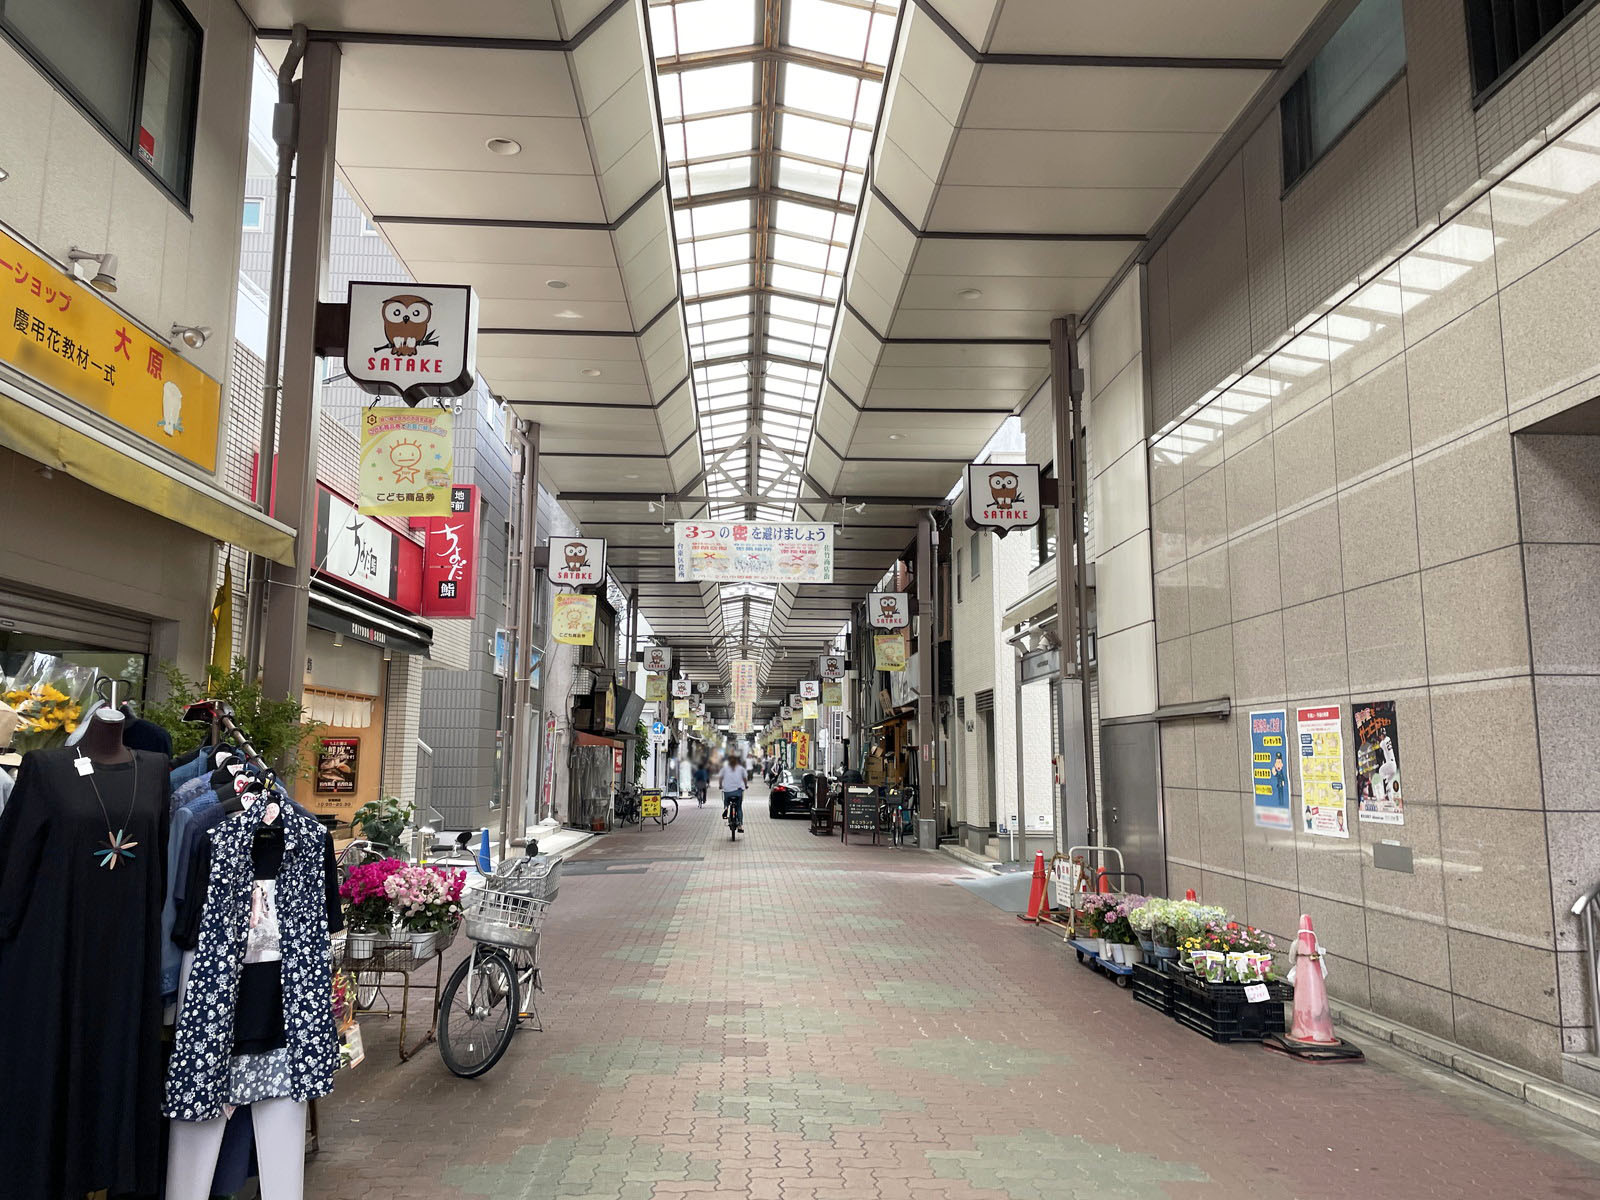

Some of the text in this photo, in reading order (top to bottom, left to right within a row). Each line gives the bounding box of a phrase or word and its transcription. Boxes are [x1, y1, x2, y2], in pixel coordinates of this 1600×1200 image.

[13, 307, 117, 387] 慶弔花教材一式
[367, 357, 443, 373] SATAKE
[376, 492, 435, 502] こども商品券
[983, 510, 1028, 520] SATAKE
[685, 525, 826, 541] 3つの密を避けましょう
[557, 571, 593, 580] SATAKE
